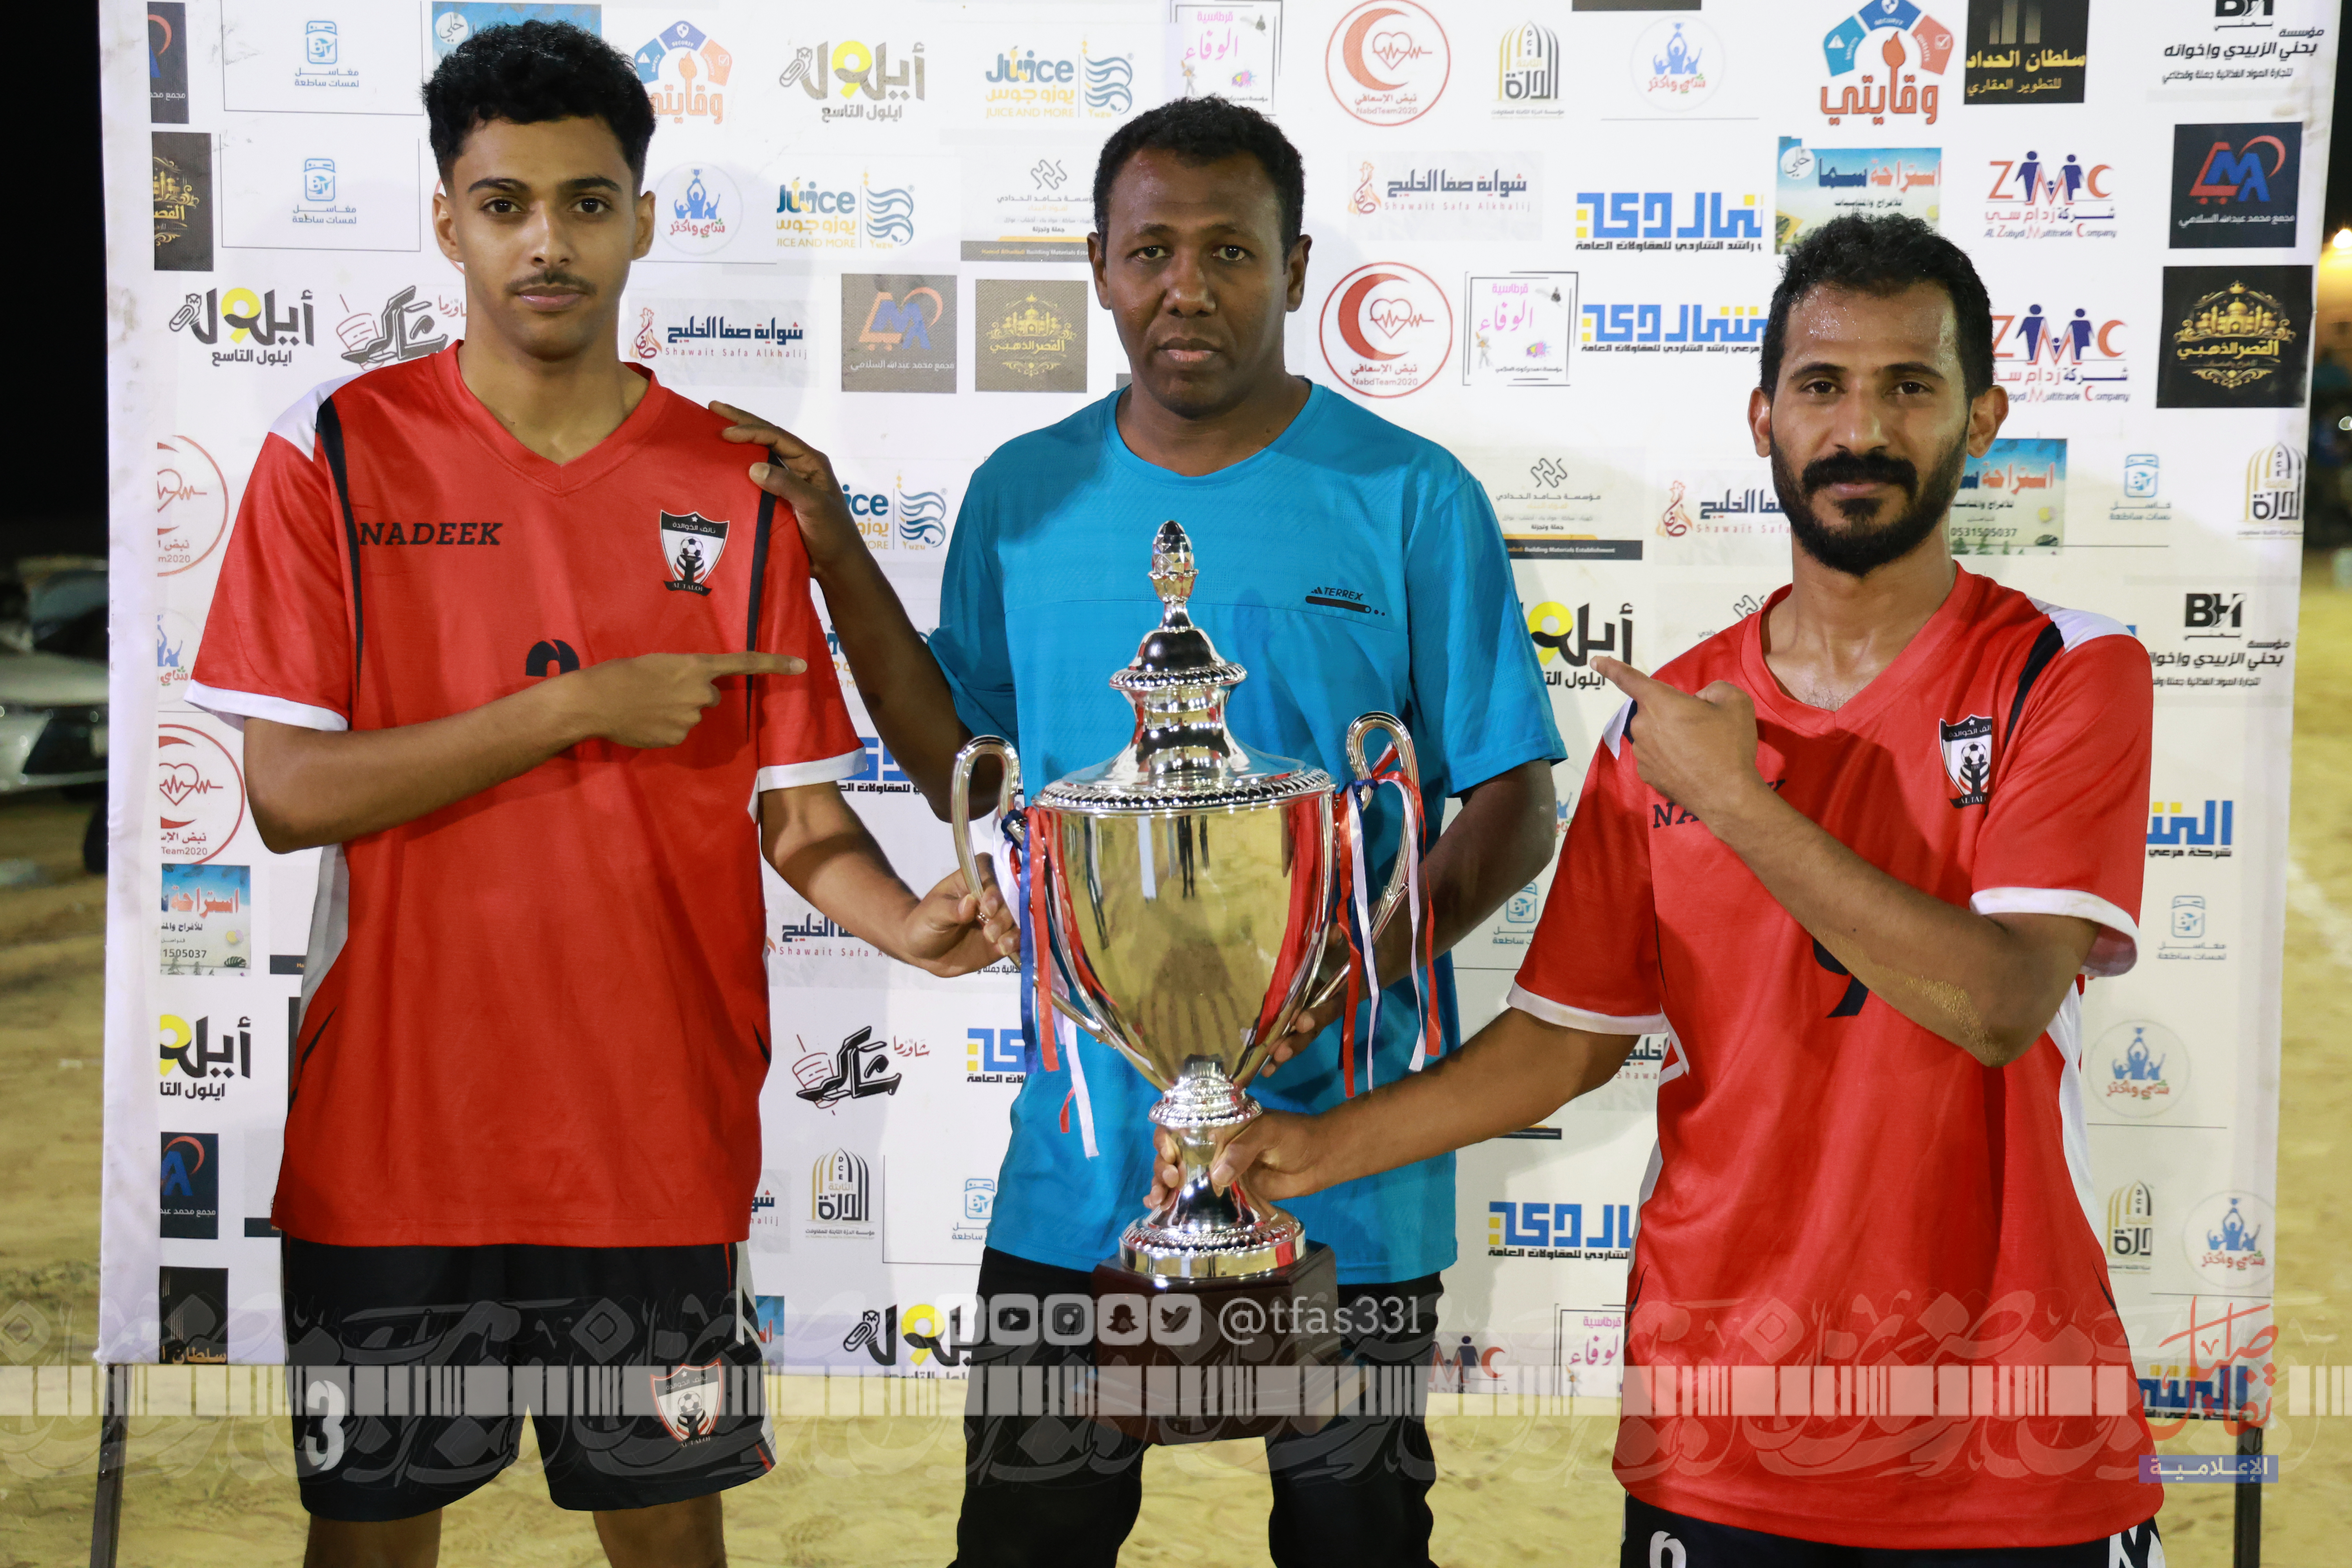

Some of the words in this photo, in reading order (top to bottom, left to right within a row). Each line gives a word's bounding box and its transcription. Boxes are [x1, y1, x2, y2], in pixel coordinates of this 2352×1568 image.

[2278, 26, 2325, 38] مؤسسة
[1184, 27, 1238, 60] الوفاء
[2223, 41, 2278, 60] الزبيدي
[1965, 49, 2020, 69] الحداد
[2025, 49, 2087, 73] سلطان
[295, 67, 359, 77] مغاسل
[328, 79, 359, 87] لمسات
[1966, 78, 2013, 96] العقاري
[986, 87, 1037, 103] جوس
[1820, 67, 1939, 125] وقايتي
[821, 105, 862, 122] التاسع
[985, 107, 1014, 118] JUICE
[1015, 107, 1041, 118] AND
[1044, 107, 1074, 118] MORE
[1387, 169, 1437, 198] الخليج
[1440, 169, 1473, 192] صفا
[1477, 169, 1527, 198] شواية
[292, 205, 357, 214] مغاسل
[1443, 202, 1470, 211] Safa
[798, 238, 822, 247] AND
[826, 239, 856, 248] MORE
[1575, 241, 1613, 250] العامة
[1616, 241, 1672, 252] للمقاولات
[1492, 283, 1528, 296] قرطاسية
[1479, 299, 1533, 332] الوفاء
[667, 316, 717, 344] الخليج
[719, 316, 751, 341] صفا
[755, 321, 804, 345] شواية
[989, 340, 1035, 354] الذهبي
[1033, 339, 1065, 354] القصر
[1614, 345, 1661, 354] للمقاولات
[2176, 341, 2239, 360] الذهبي
[2232, 339, 2280, 360] القصر
[212, 350, 253, 367] التاسع
[256, 350, 292, 367] ايلول
[665, 347, 715, 357] Shawait
[722, 348, 750, 358] Safa
[757, 348, 807, 360] Alkhalij
[934, 363, 955, 372] مجمع
[1350, 363, 1394, 376] الإسعافي
[1395, 363, 1418, 375] نبض
[1352, 377, 1418, 386] NabdTeam2020
[1564, 493, 1601, 501] مؤسسة
[1700, 488, 1756, 520] الخليج
[672, 521, 698, 531] الخوالدة
[1696, 524, 1752, 533] Shawait
[1761, 524, 1791, 534] Safa
[359, 521, 503, 546] NADEEK
[902, 540, 926, 550] Yuzu
[1323, 586, 1364, 601] TERREX
[2184, 593, 2246, 628] BH
[2193, 652, 2247, 669] الزبيدي
[857, 783, 910, 795] للمقاولات
[182, 832, 207, 844] نبض
[161, 846, 208, 856] Team2020
[2187, 848, 2232, 859] شركة
[171, 885, 239, 919] استراحة
[163, 949, 207, 958] 1505037
[779, 947, 833, 956] Shawait
[841, 947, 869, 957] Safa
[967, 1073, 1003, 1083] العامة
[1617, 1071, 1658, 1080] Shawa
[185, 1082, 225, 1100] ايلول
[196, 1209, 216, 1218] مجمع
[1488, 1247, 1525, 1257] العامة
[1527, 1249, 1582, 1260] للمقاولات
[305, 1379, 346, 1471] 3
